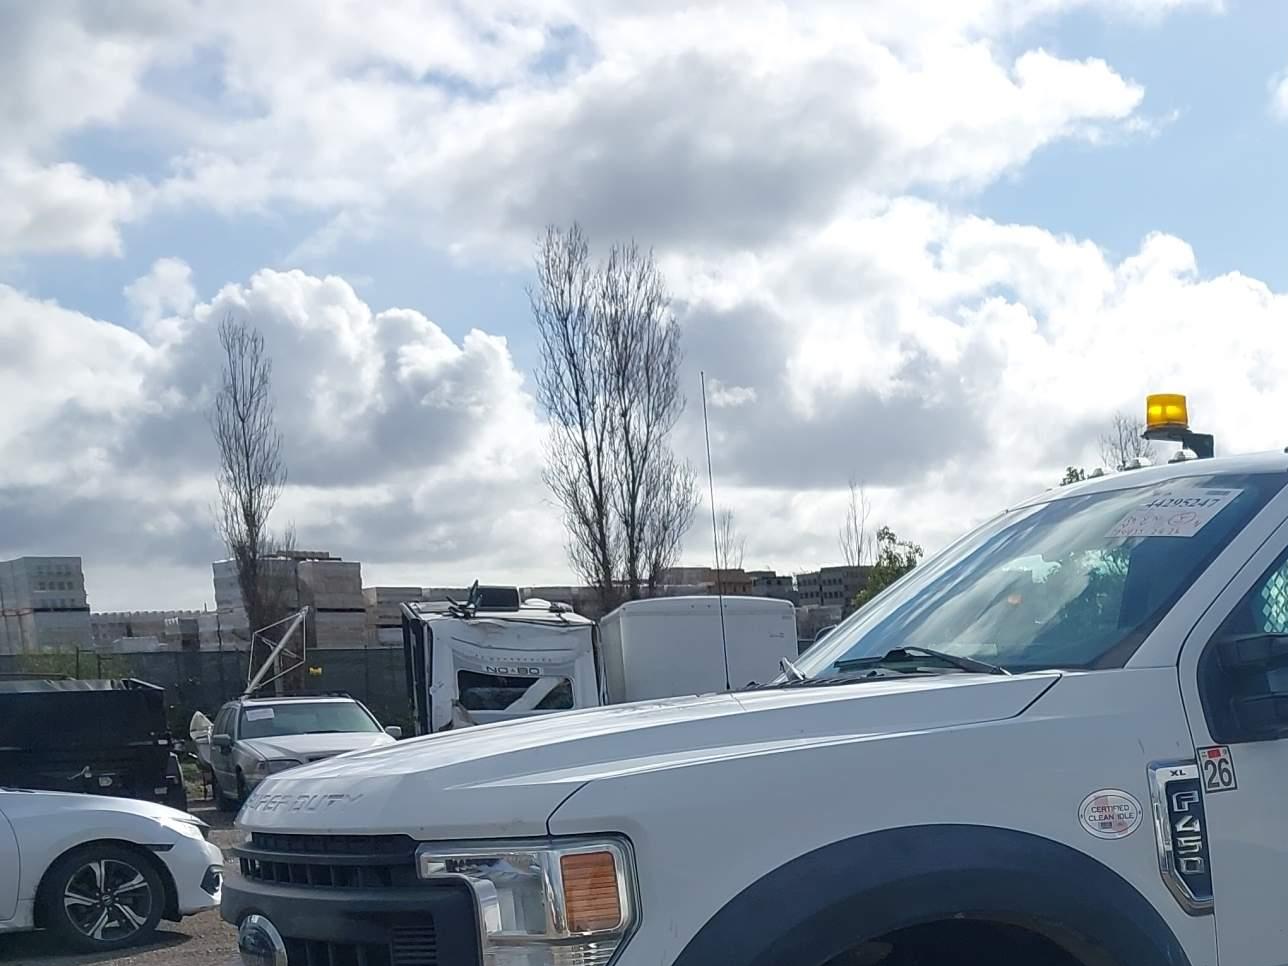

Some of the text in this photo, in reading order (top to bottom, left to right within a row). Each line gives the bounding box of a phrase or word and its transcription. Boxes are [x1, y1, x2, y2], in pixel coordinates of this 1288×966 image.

[1170, 769, 1187, 777] XL
[1204, 758, 1233, 789] 26
[1091, 804, 1130, 814] CERTIFIED
[1088, 812, 1135, 822] CLEAN IDLE
[1172, 790, 1205, 874] F450
